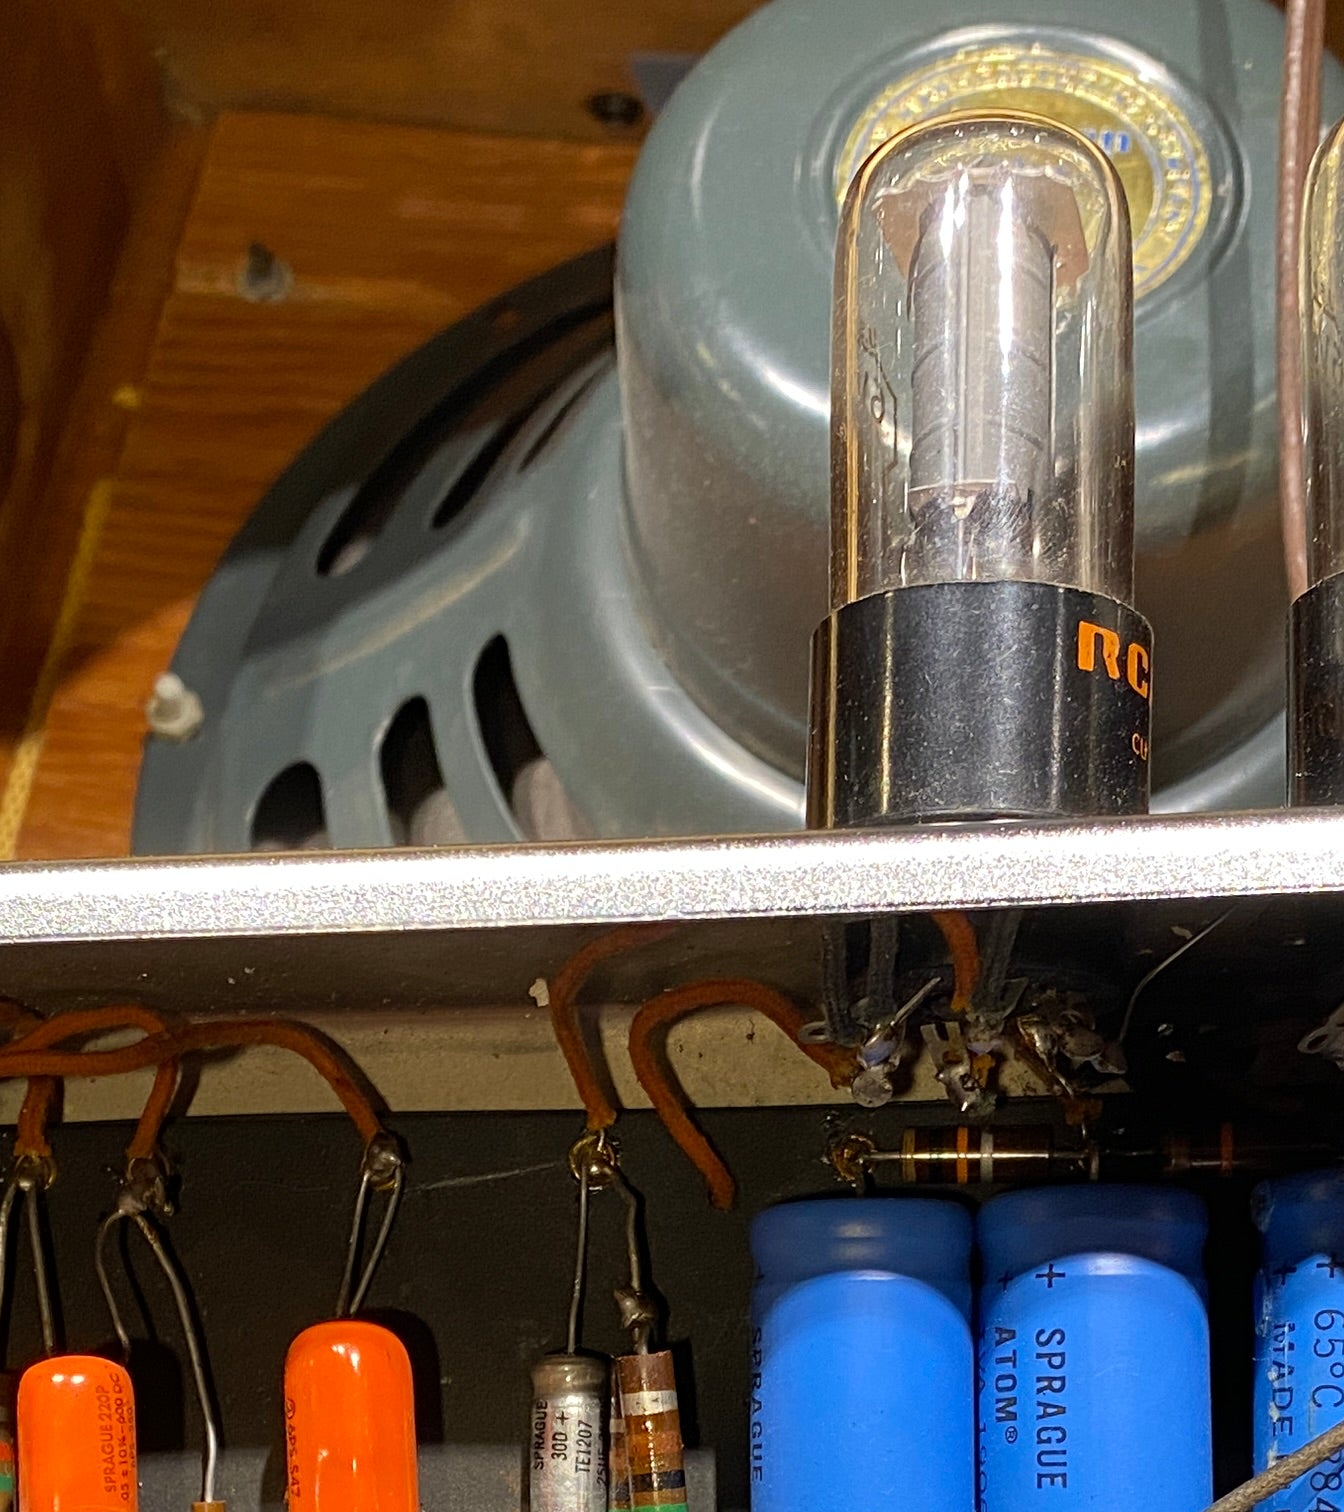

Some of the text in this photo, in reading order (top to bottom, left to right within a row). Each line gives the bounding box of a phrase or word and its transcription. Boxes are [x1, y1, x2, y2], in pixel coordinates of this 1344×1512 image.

[751, 1326, 764, 1483] SPRAGUE
[1034, 1327, 1068, 1490] SPRAGUE
[1271, 1321, 1297, 1437] MADE
[96, 1384, 117, 1493] SPRAGUE 220P
[534, 1399, 548, 1471] SPRAGUE
[550, 1431, 568, 1461] 30D
[575, 1418, 593, 1474] TE1207
